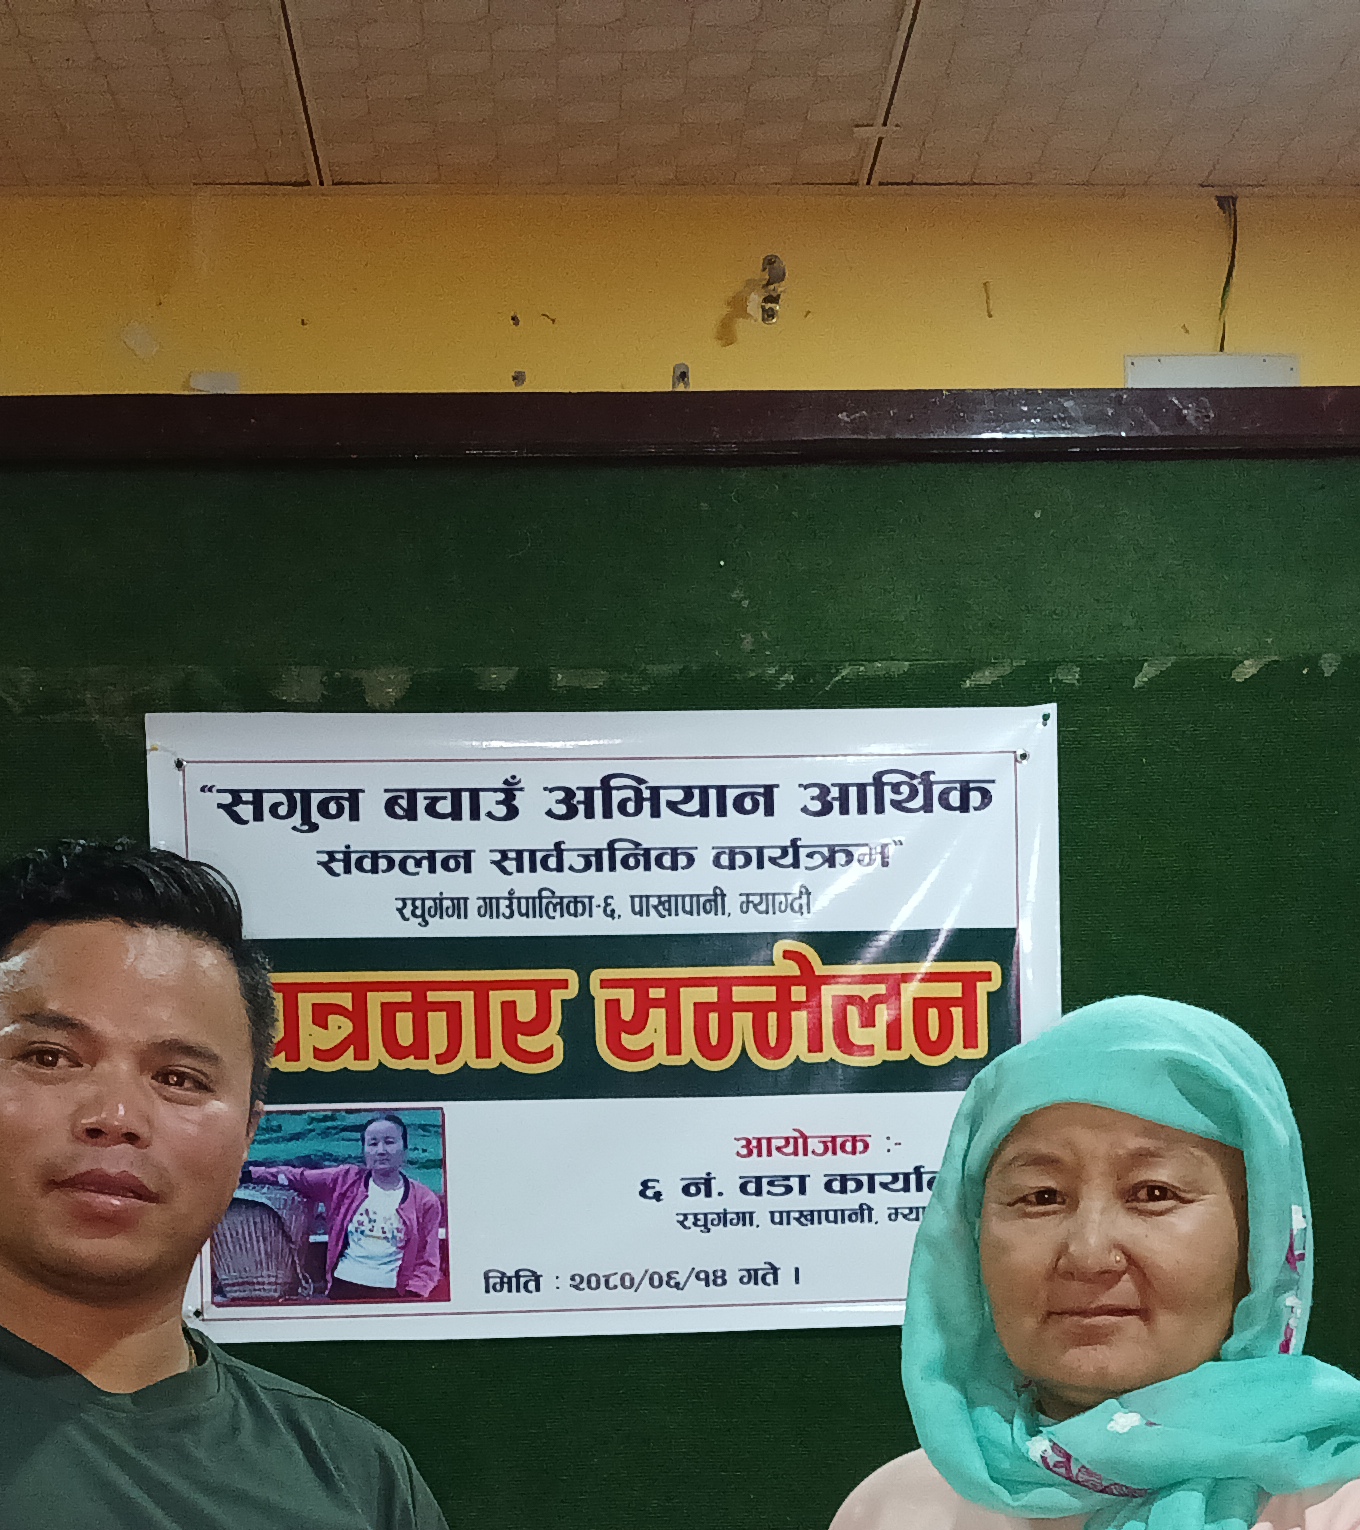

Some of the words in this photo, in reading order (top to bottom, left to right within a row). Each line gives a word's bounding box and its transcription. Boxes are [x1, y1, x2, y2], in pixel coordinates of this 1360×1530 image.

[382, 774, 526, 822] बचाउँ
[542, 772, 781, 822] अभियान
[797, 768, 997, 818] आर्थिक
[315, 843, 477, 878] संकलन
[488, 837, 699, 877] सार्वजनिक
[394, 890, 471, 928] रघुगंगा
[628, 885, 733, 919] पाखापानी,
[738, 883, 813, 917] म्याग्दी
[595, 944, 997, 1067] सम्मेलन
[733, 1127, 872, 1159] आयोजक
[638, 1177, 664, 1203] ६
[679, 1171, 725, 1199] नं.
[738, 1173, 811, 1198] वडा
[886, 1205, 927, 1223] म्या
[482, 1267, 544, 1296] मिति
[568, 1265, 728, 1293] २०८०/०६/१४
[737, 1261, 782, 1288] गते
